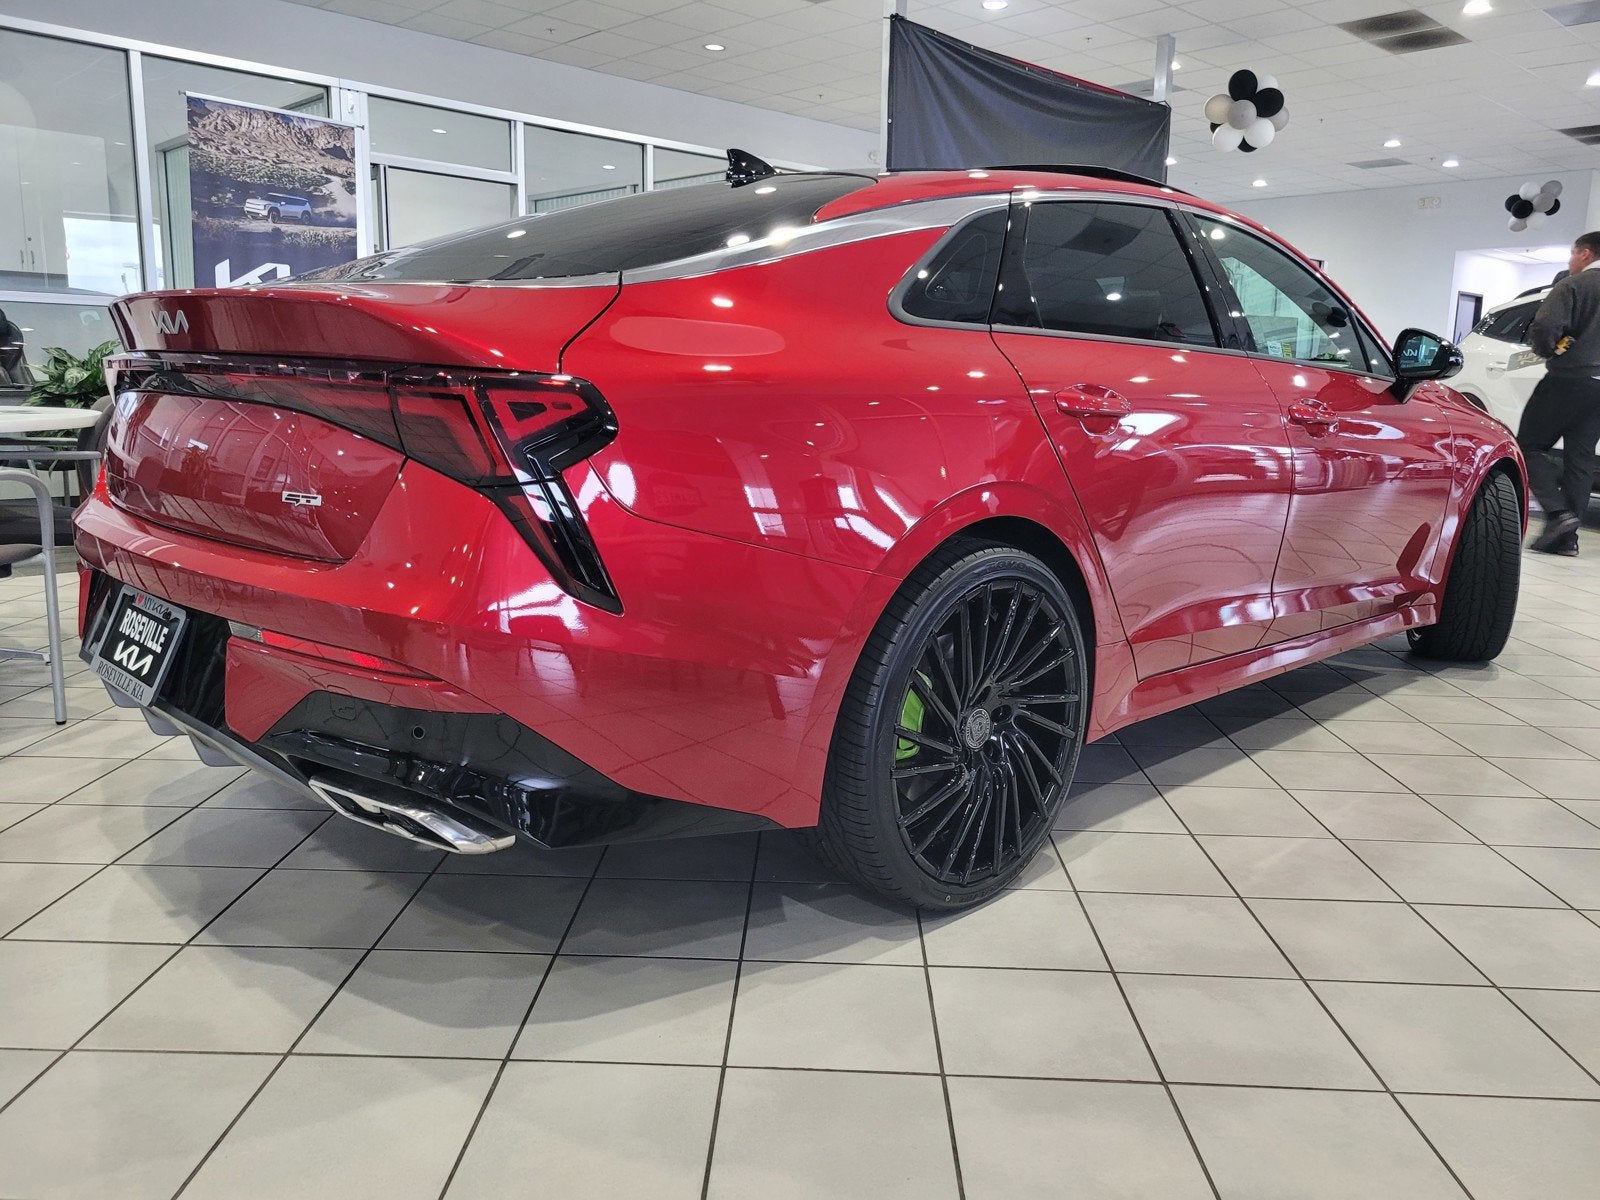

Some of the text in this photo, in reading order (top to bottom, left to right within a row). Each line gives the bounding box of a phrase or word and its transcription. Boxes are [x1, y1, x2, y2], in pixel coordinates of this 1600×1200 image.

[150, 310, 189, 335] KIA
[119, 608, 169, 654] ROSEVILLE
[113, 640, 154, 677] KIA
[96, 660, 145, 701] ROSEVILLE KIA
